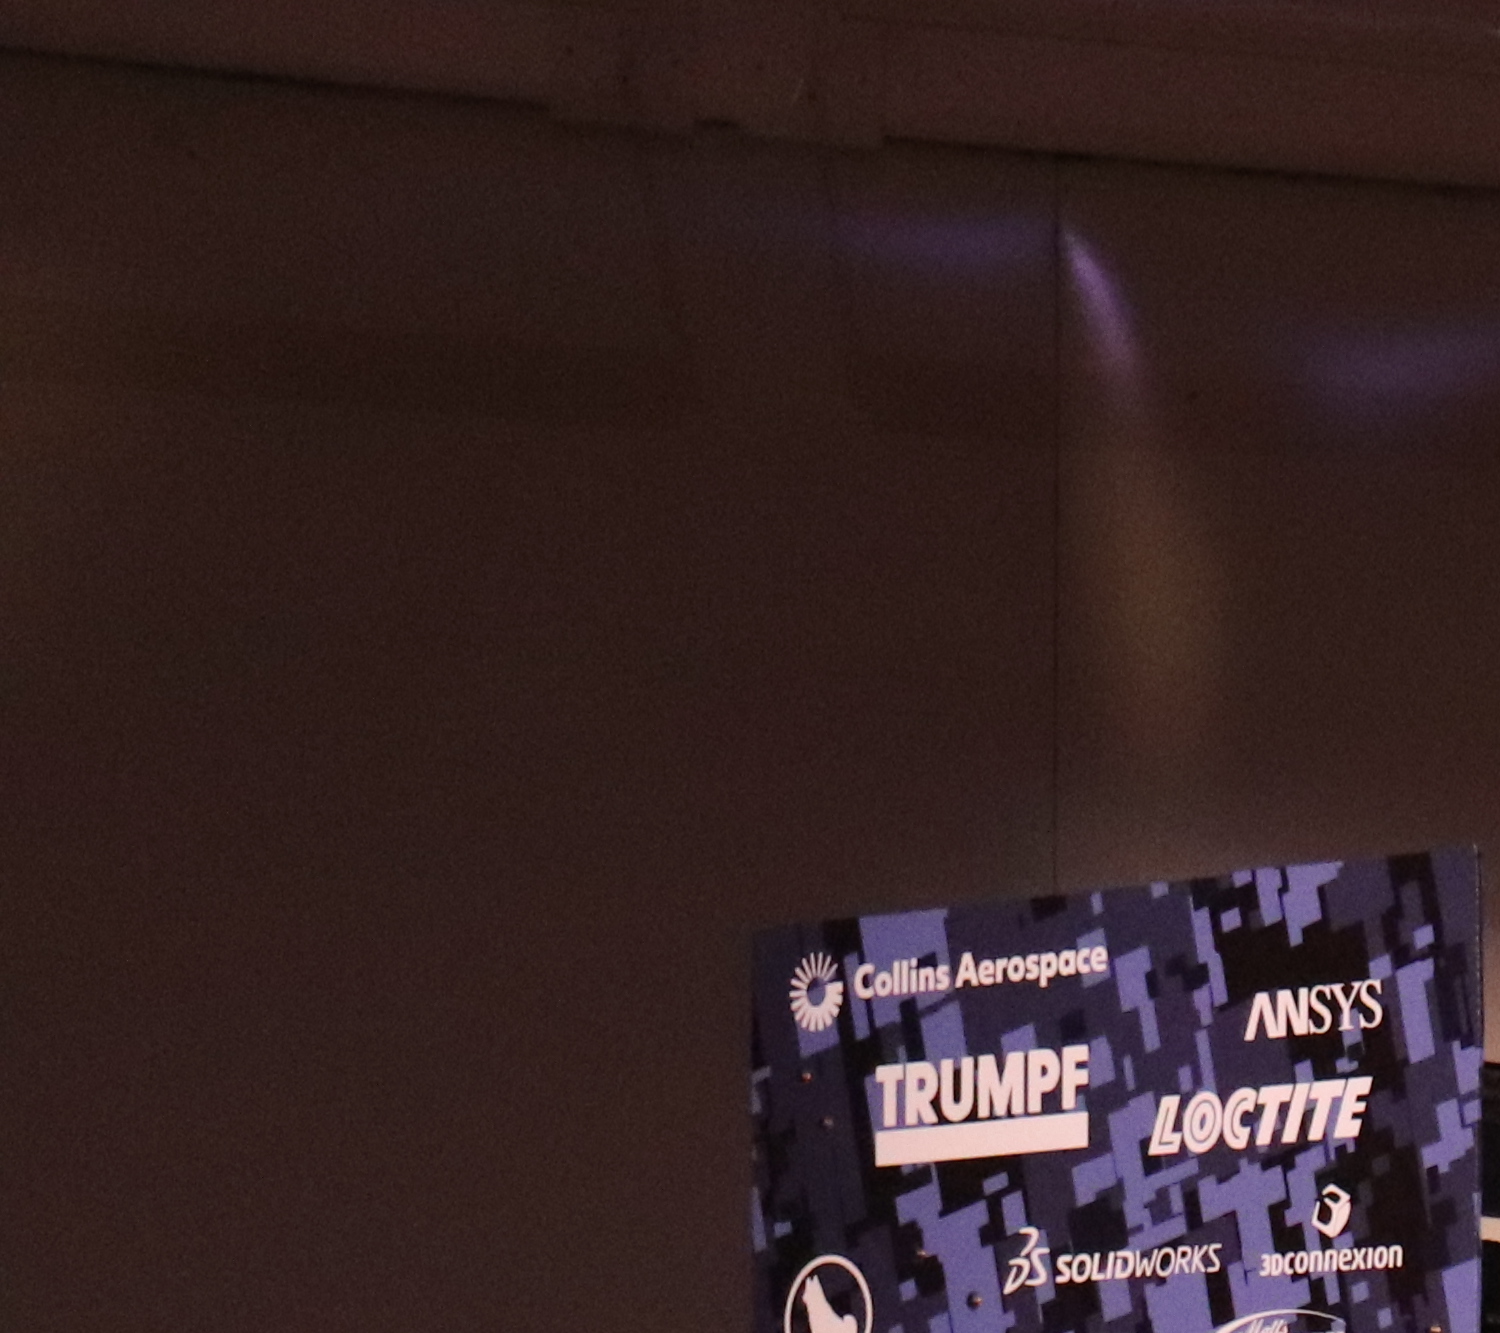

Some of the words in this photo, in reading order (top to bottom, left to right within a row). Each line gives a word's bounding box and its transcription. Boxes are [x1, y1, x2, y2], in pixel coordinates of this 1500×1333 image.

[854, 961, 950, 999] Collins
[956, 946, 1108, 993] Aerospace
[1244, 979, 1383, 1041] ANSYS
[875, 1044, 1089, 1128] TRUMPF
[1148, 1076, 1373, 1157] LOCTITE
[1055, 1243, 1222, 1284] SOLIDWORKS
